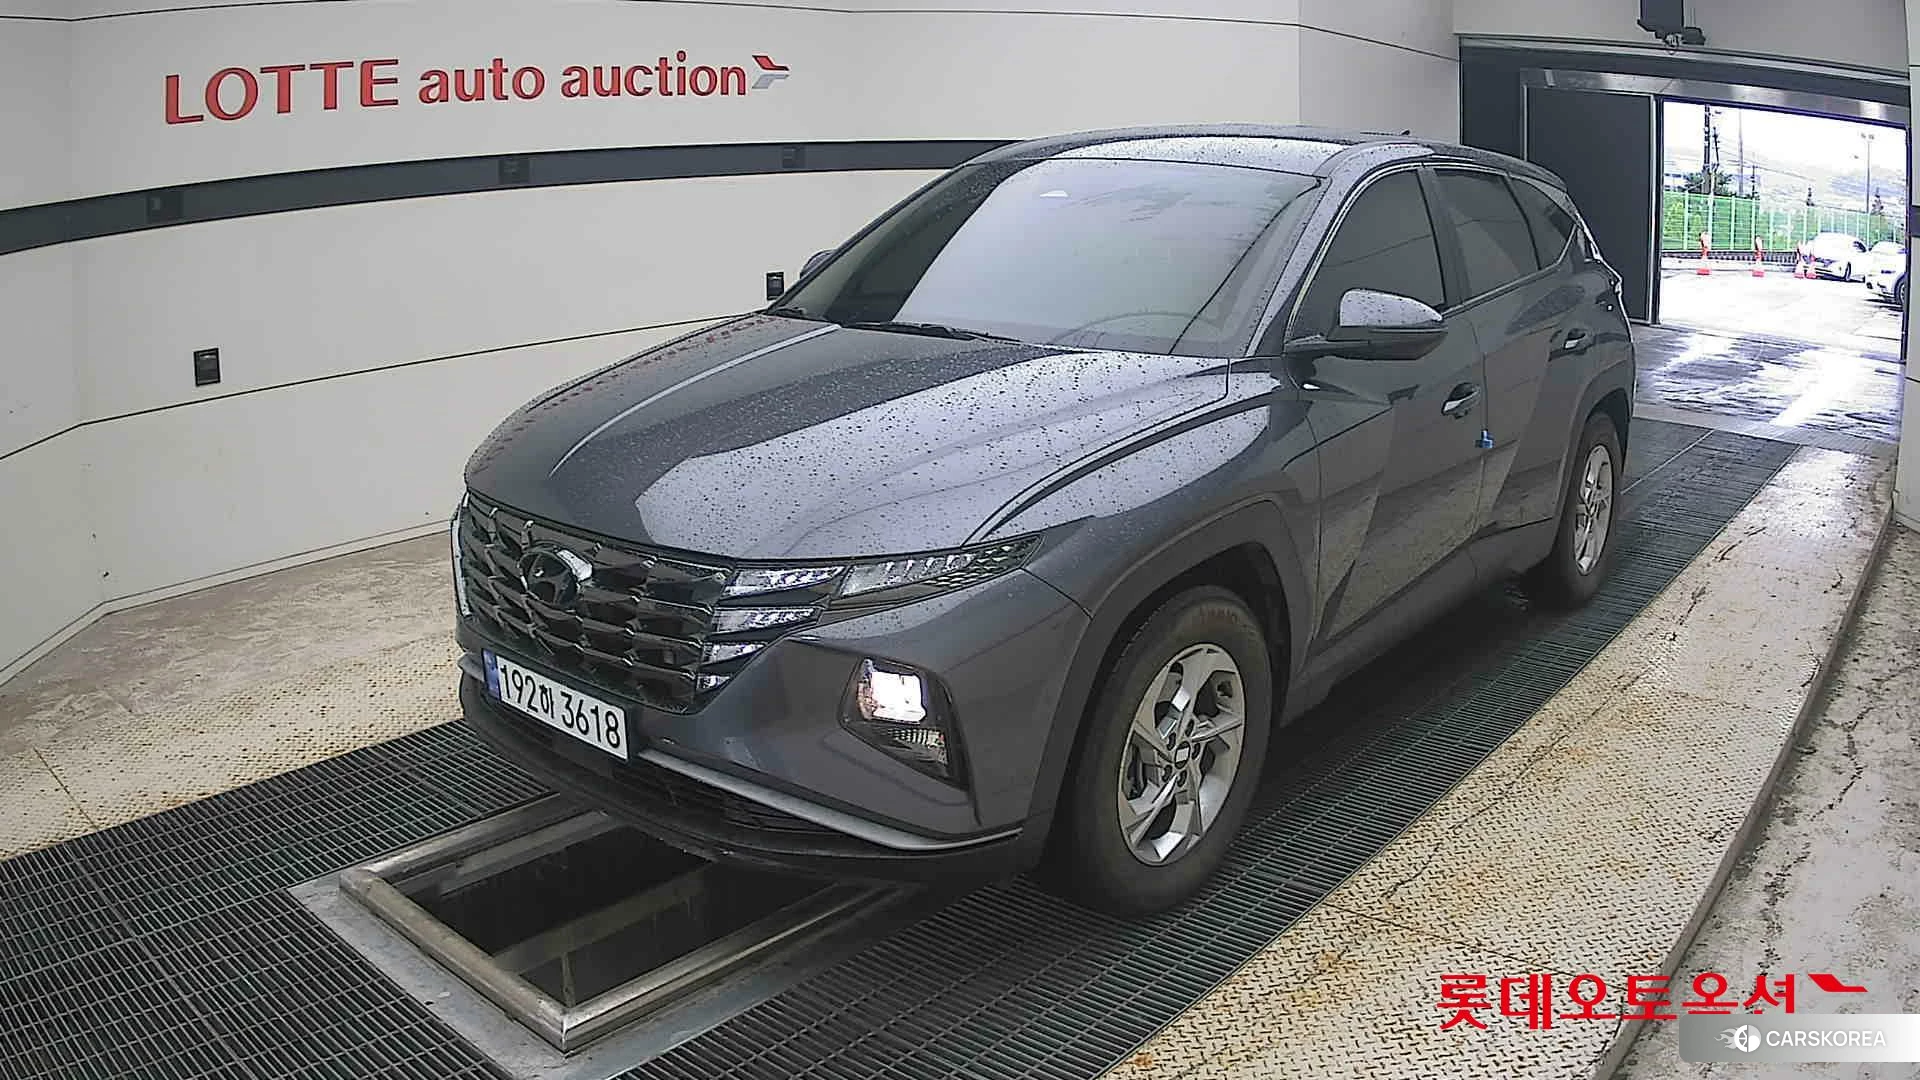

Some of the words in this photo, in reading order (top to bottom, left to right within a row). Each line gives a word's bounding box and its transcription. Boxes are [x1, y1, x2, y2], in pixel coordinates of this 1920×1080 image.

[164, 58, 399, 125] LOTTE
[417, 57, 546, 104] auto
[560, 50, 748, 98] auction
[560, 692, 621, 749] 3618
